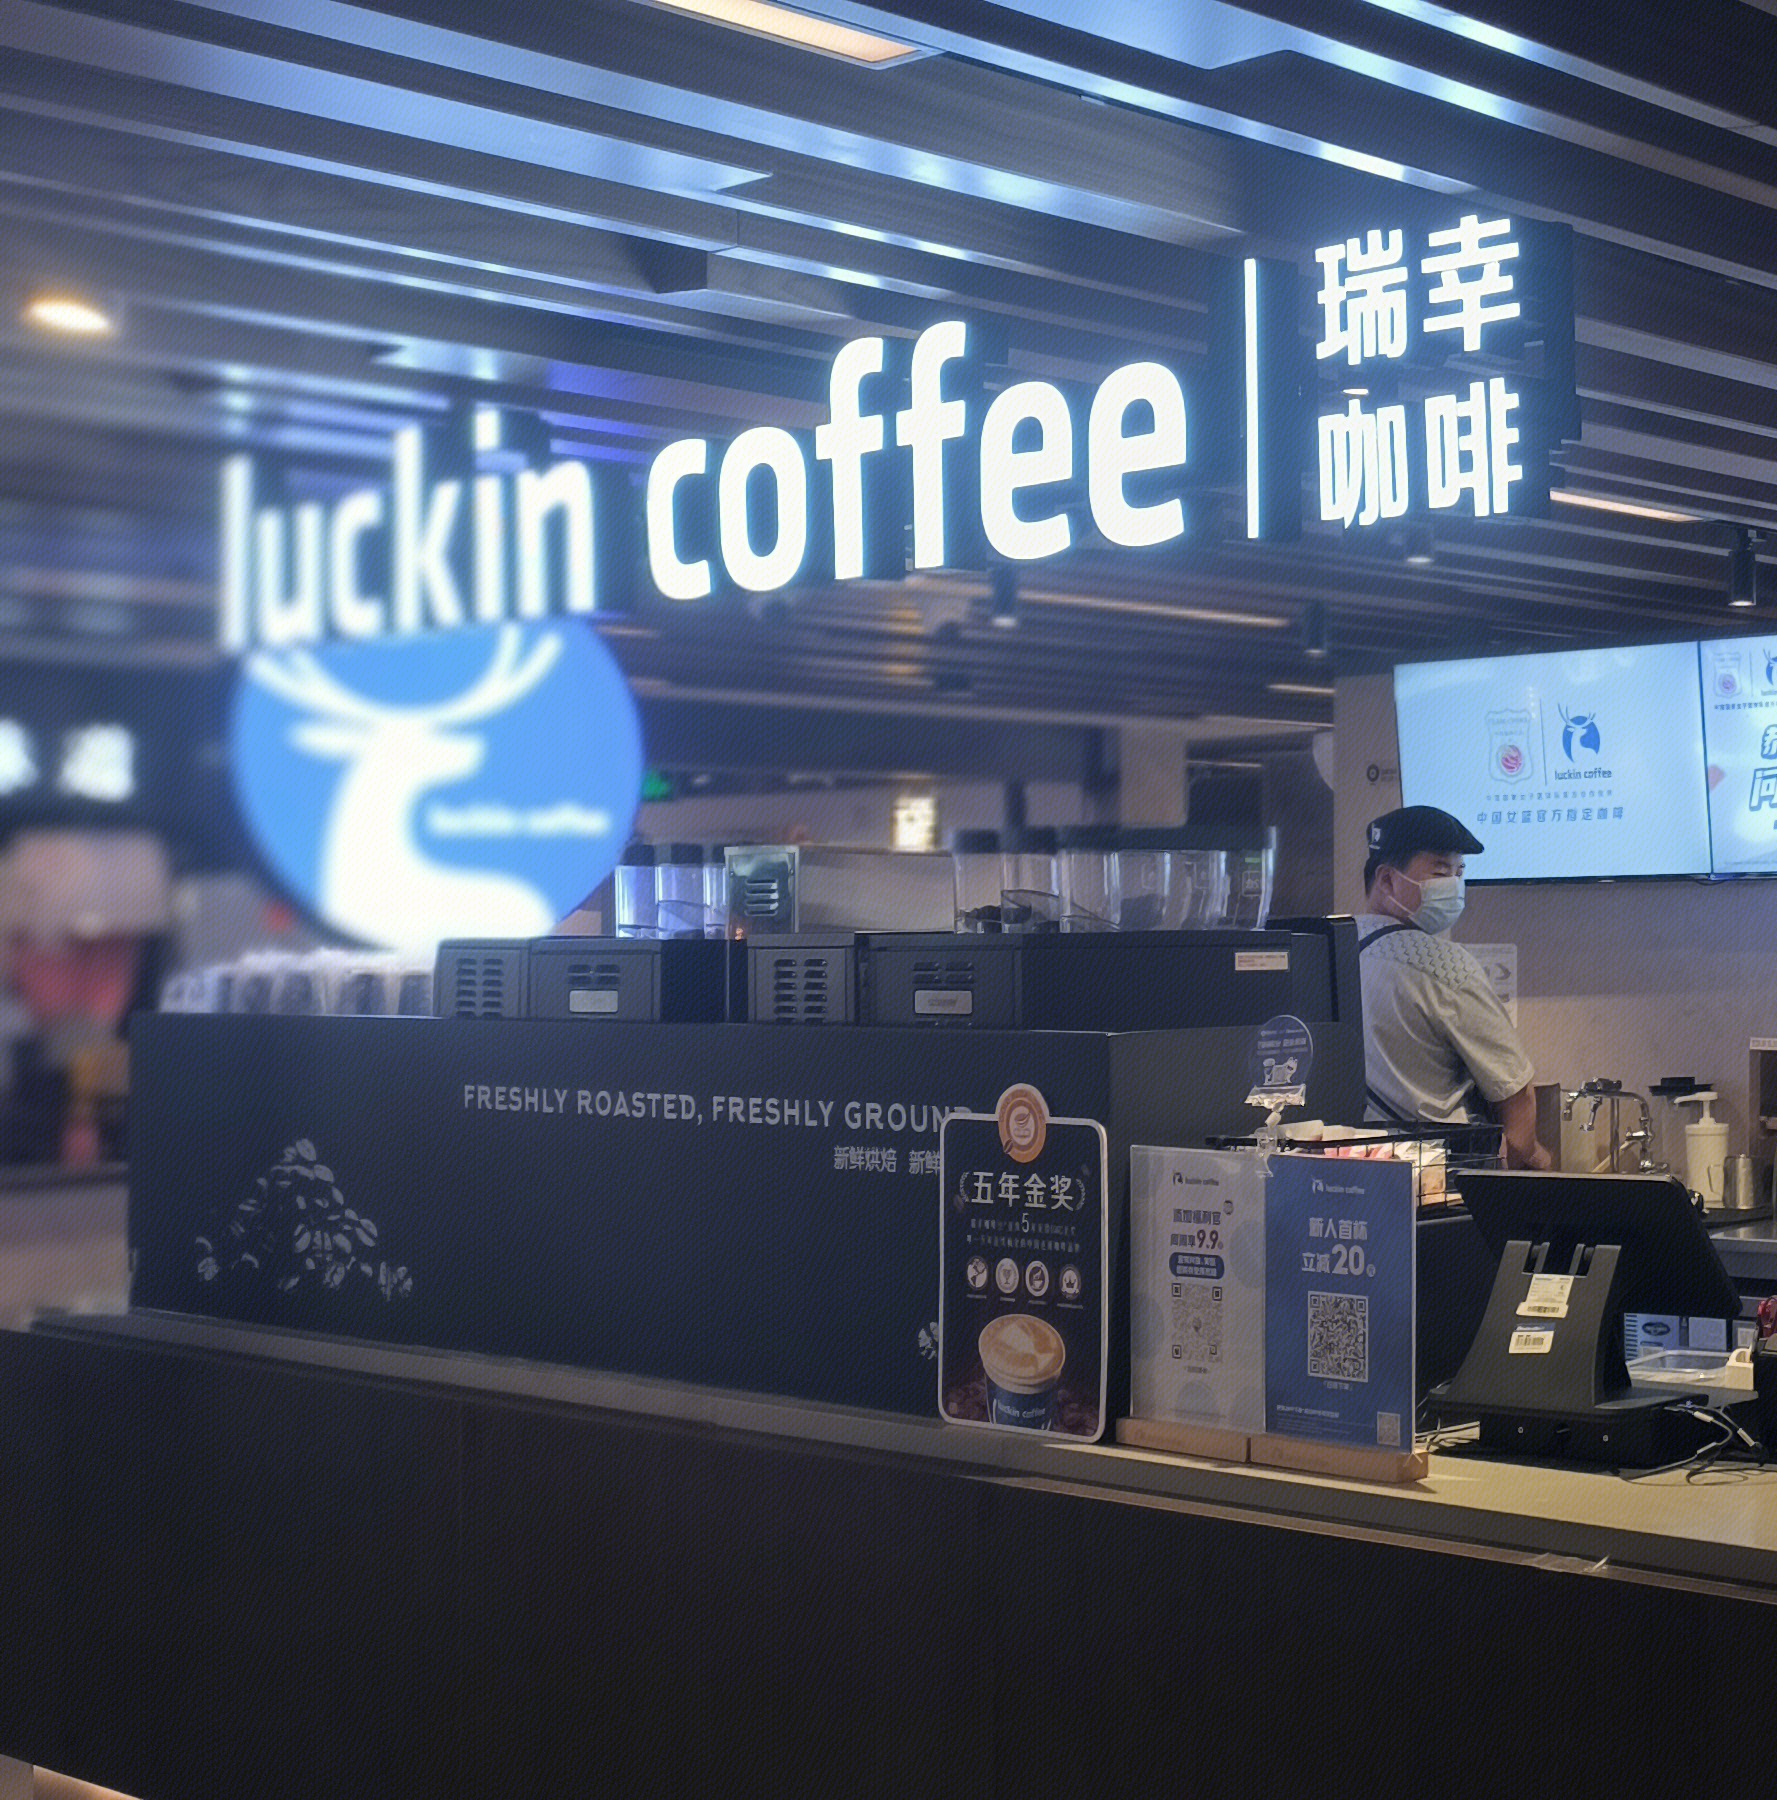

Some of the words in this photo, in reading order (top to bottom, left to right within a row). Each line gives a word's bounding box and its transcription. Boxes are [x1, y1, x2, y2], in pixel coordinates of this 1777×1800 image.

[1314, 213, 1521, 366] 瑞幸
[1317, 376, 1523, 530] 咖啡
[220, 406, 597, 652] luckin
[646, 320, 1188, 600] coffee
[1554, 769, 1582, 781] luckin
[1583, 767, 1612, 779] coffee
[463, 1084, 569, 1114] FRESHLY
[576, 1090, 704, 1126] ROASTED,
[712, 1095, 836, 1128] FRESHLY
[843, 1101, 973, 1133] GROUN
[833, 1145, 898, 1173] 新鲜烘焙
[971, 1171, 1074, 1211] 五年金奖
